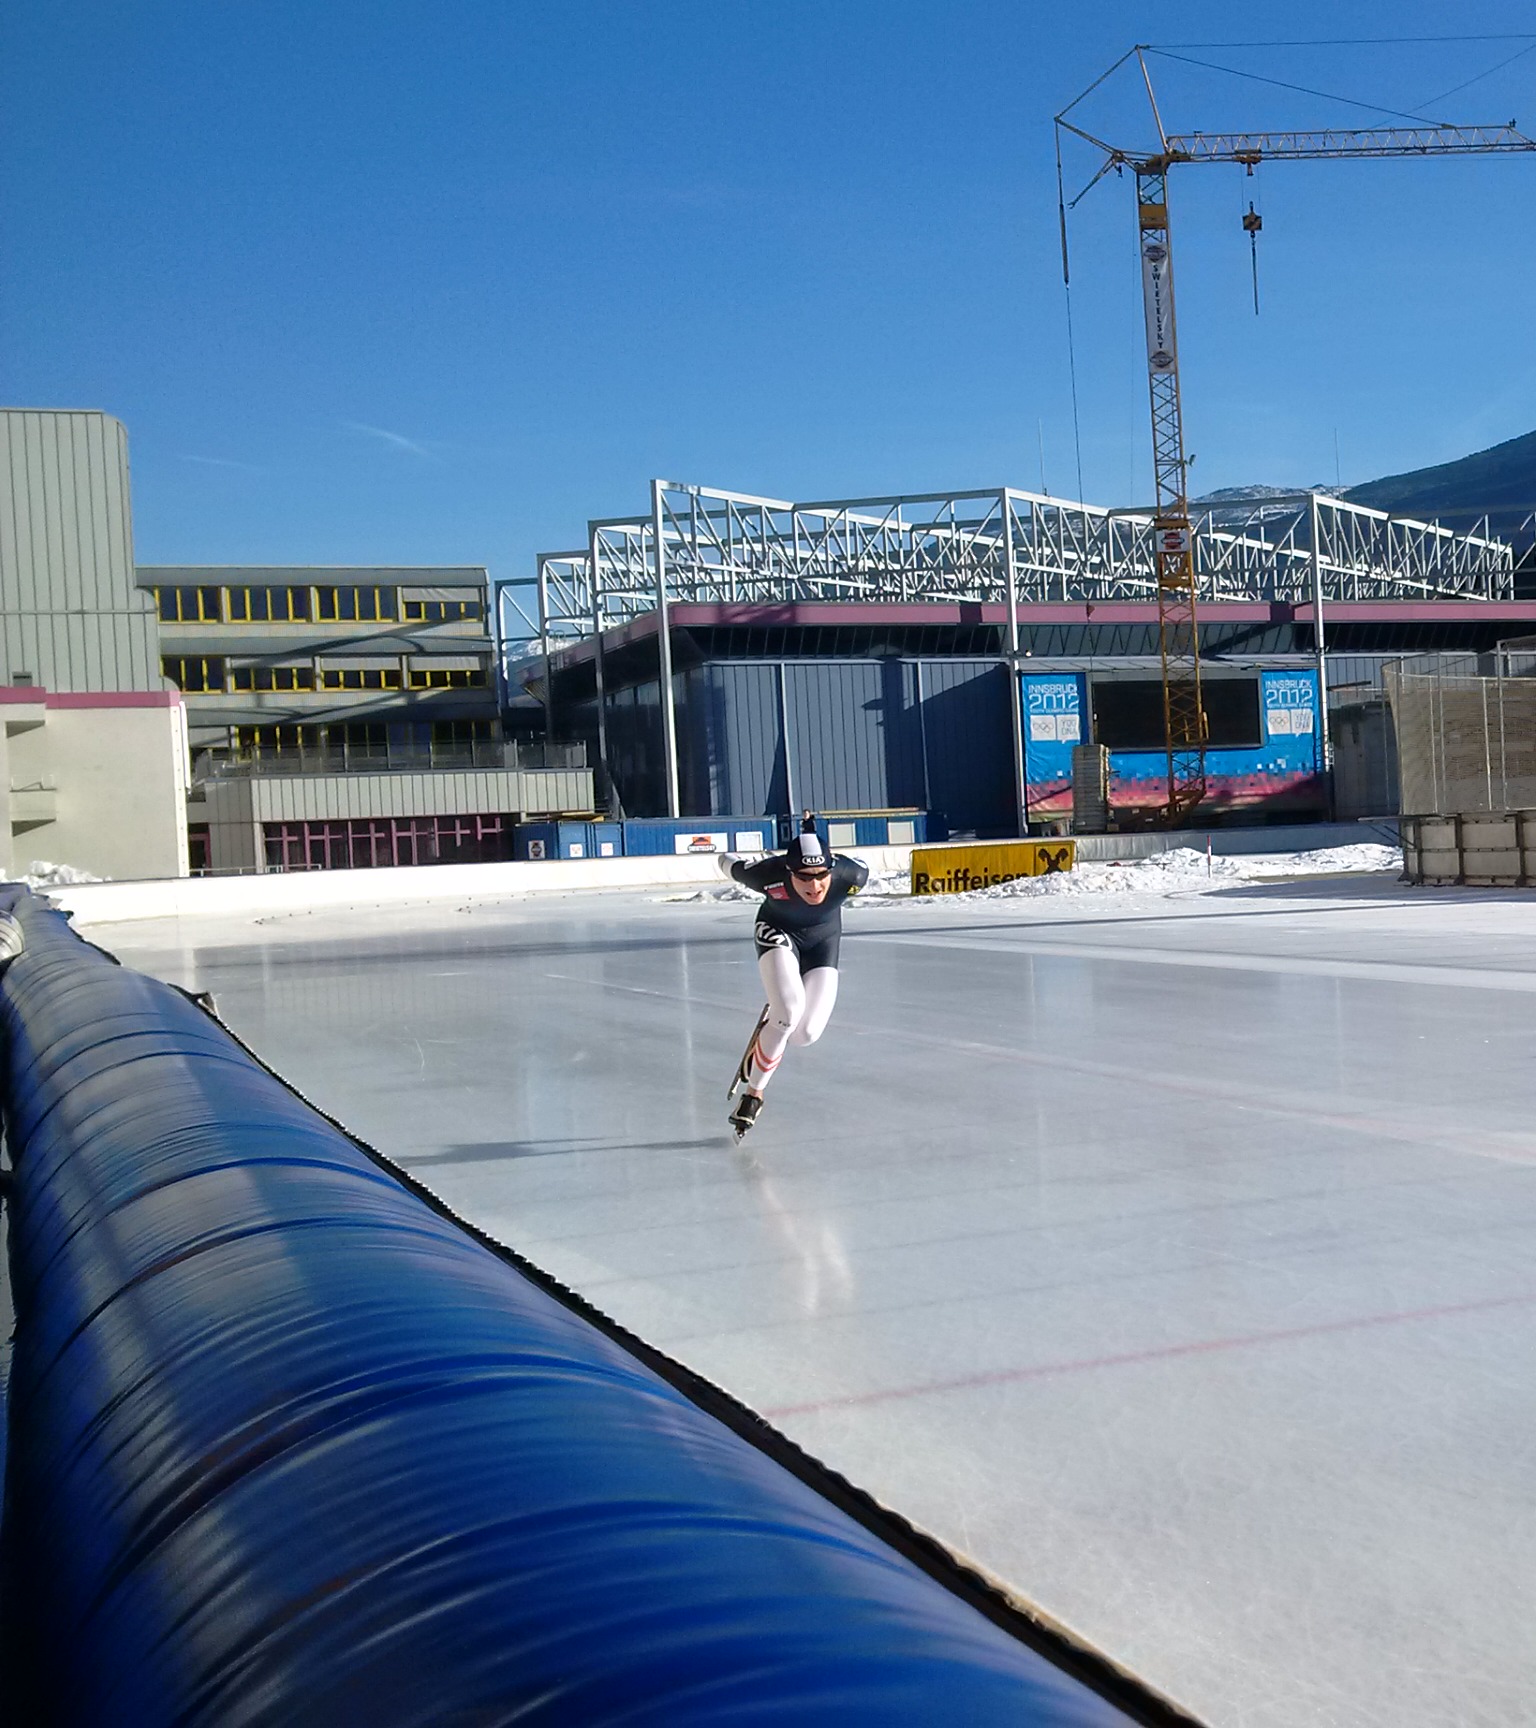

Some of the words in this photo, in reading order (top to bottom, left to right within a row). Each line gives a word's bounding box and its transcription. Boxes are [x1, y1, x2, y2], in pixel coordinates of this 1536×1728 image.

[1151, 265, 1164, 349] SWIETELSKY
[1028, 683, 1078, 694] INNSBRUCK
[1266, 679, 1312, 688] INNSBRUCK
[1029, 693, 1079, 709] 2012
[1266, 688, 1313, 704] 2012
[756, 922, 786, 945] KIA
